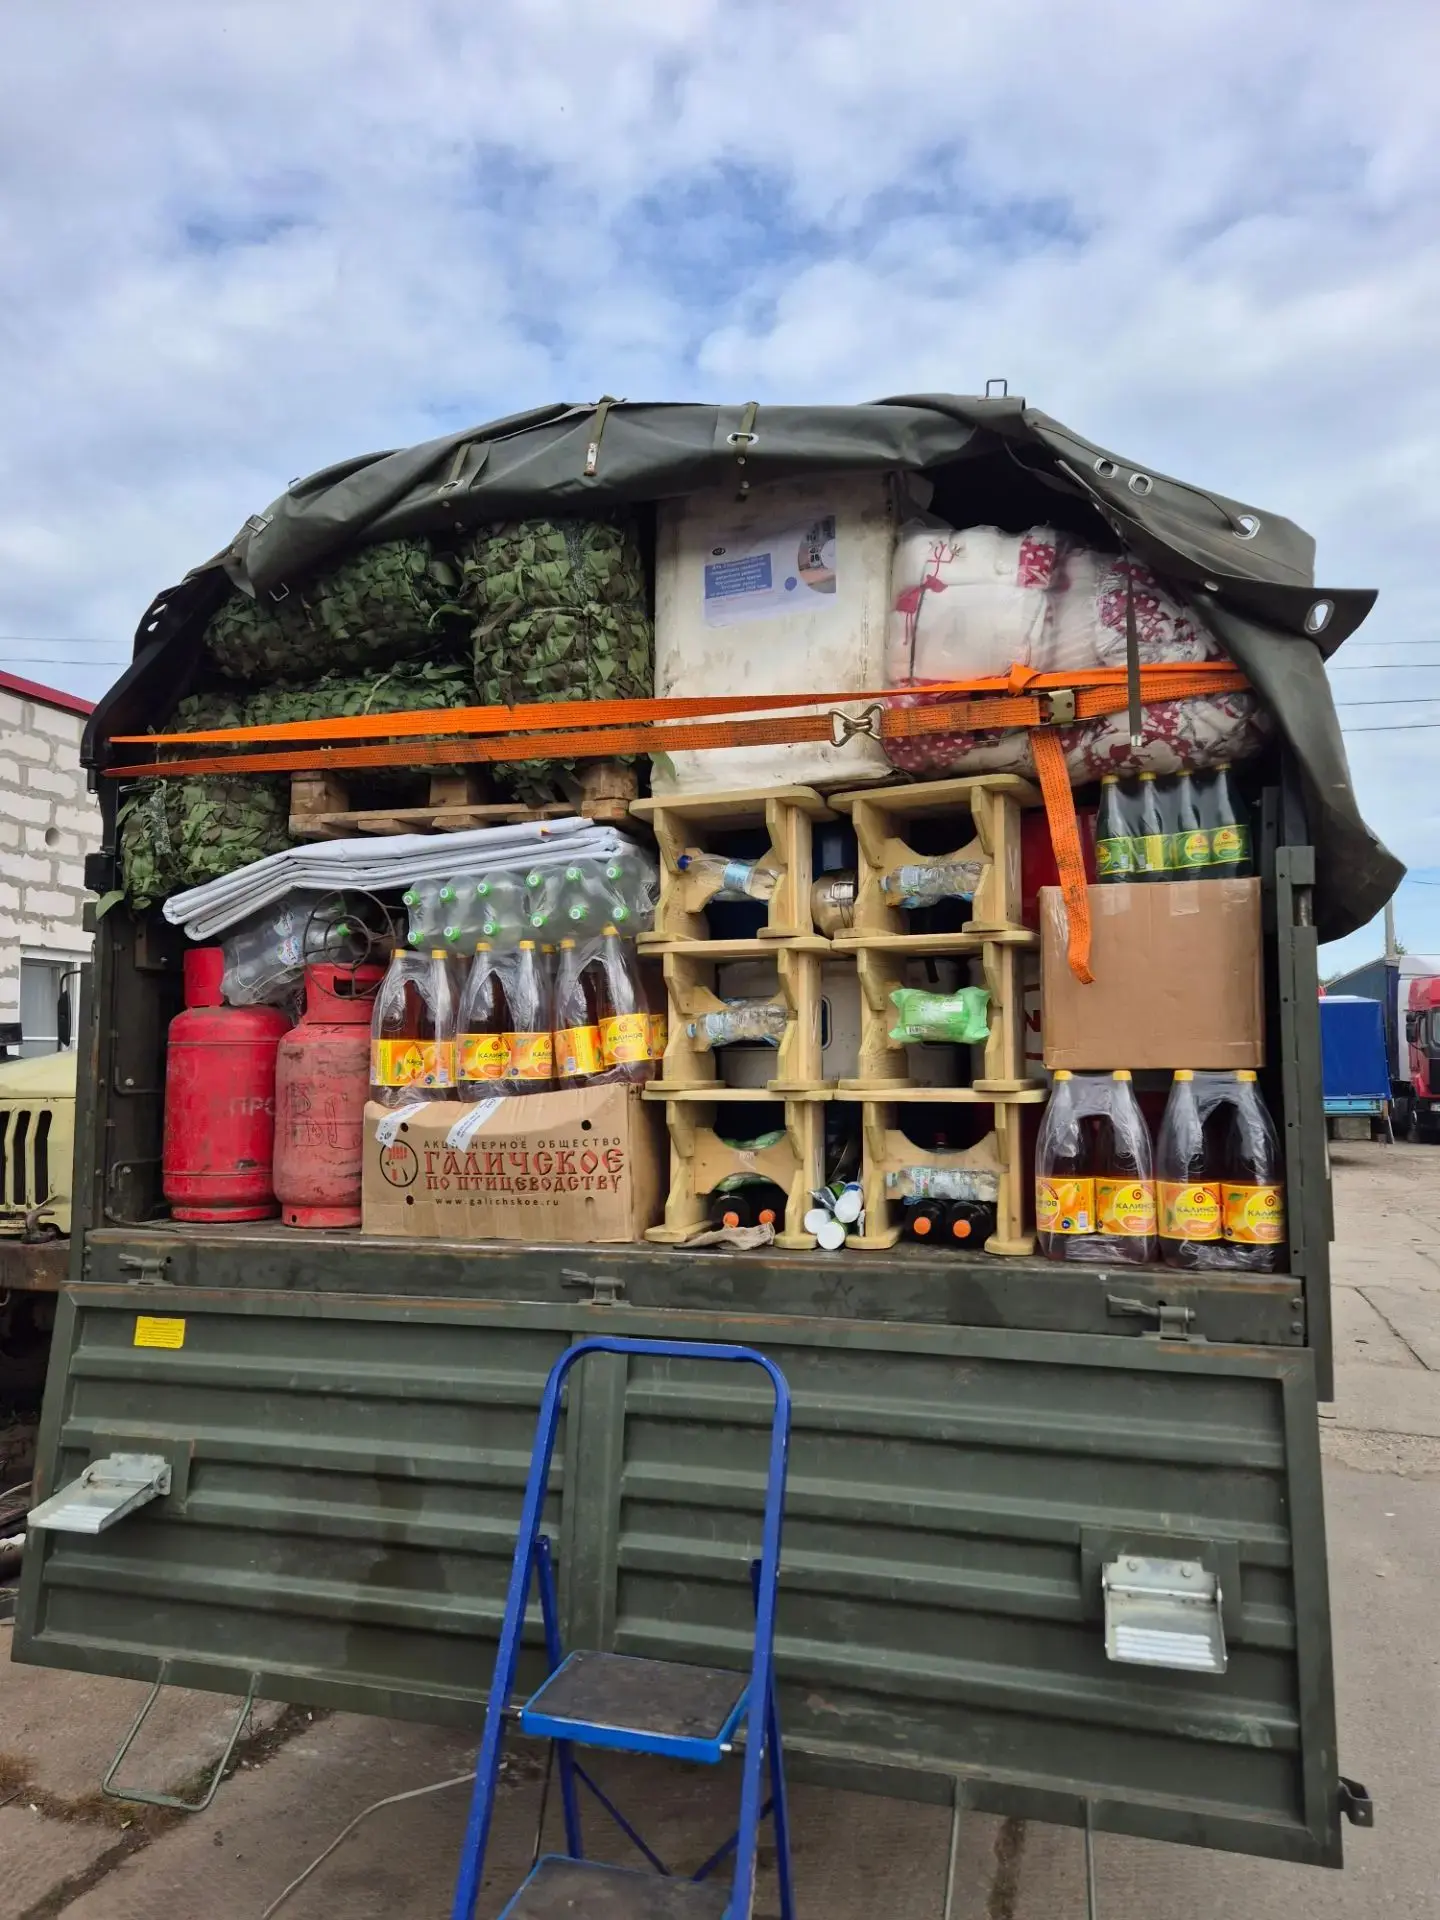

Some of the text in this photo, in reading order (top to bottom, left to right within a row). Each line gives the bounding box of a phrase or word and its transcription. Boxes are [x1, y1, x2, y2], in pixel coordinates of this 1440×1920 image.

[424, 1137, 621, 1150] АКЦНЕРНОЕ ОБЩЕСТВО
[424, 1148, 625, 1176] ГАЛИЧСКОЕ
[426, 1174, 623, 1195] ПО ПТИЦЕВОДСТВУ
[434, 1196, 560, 1207] www.galichskoe.ru
